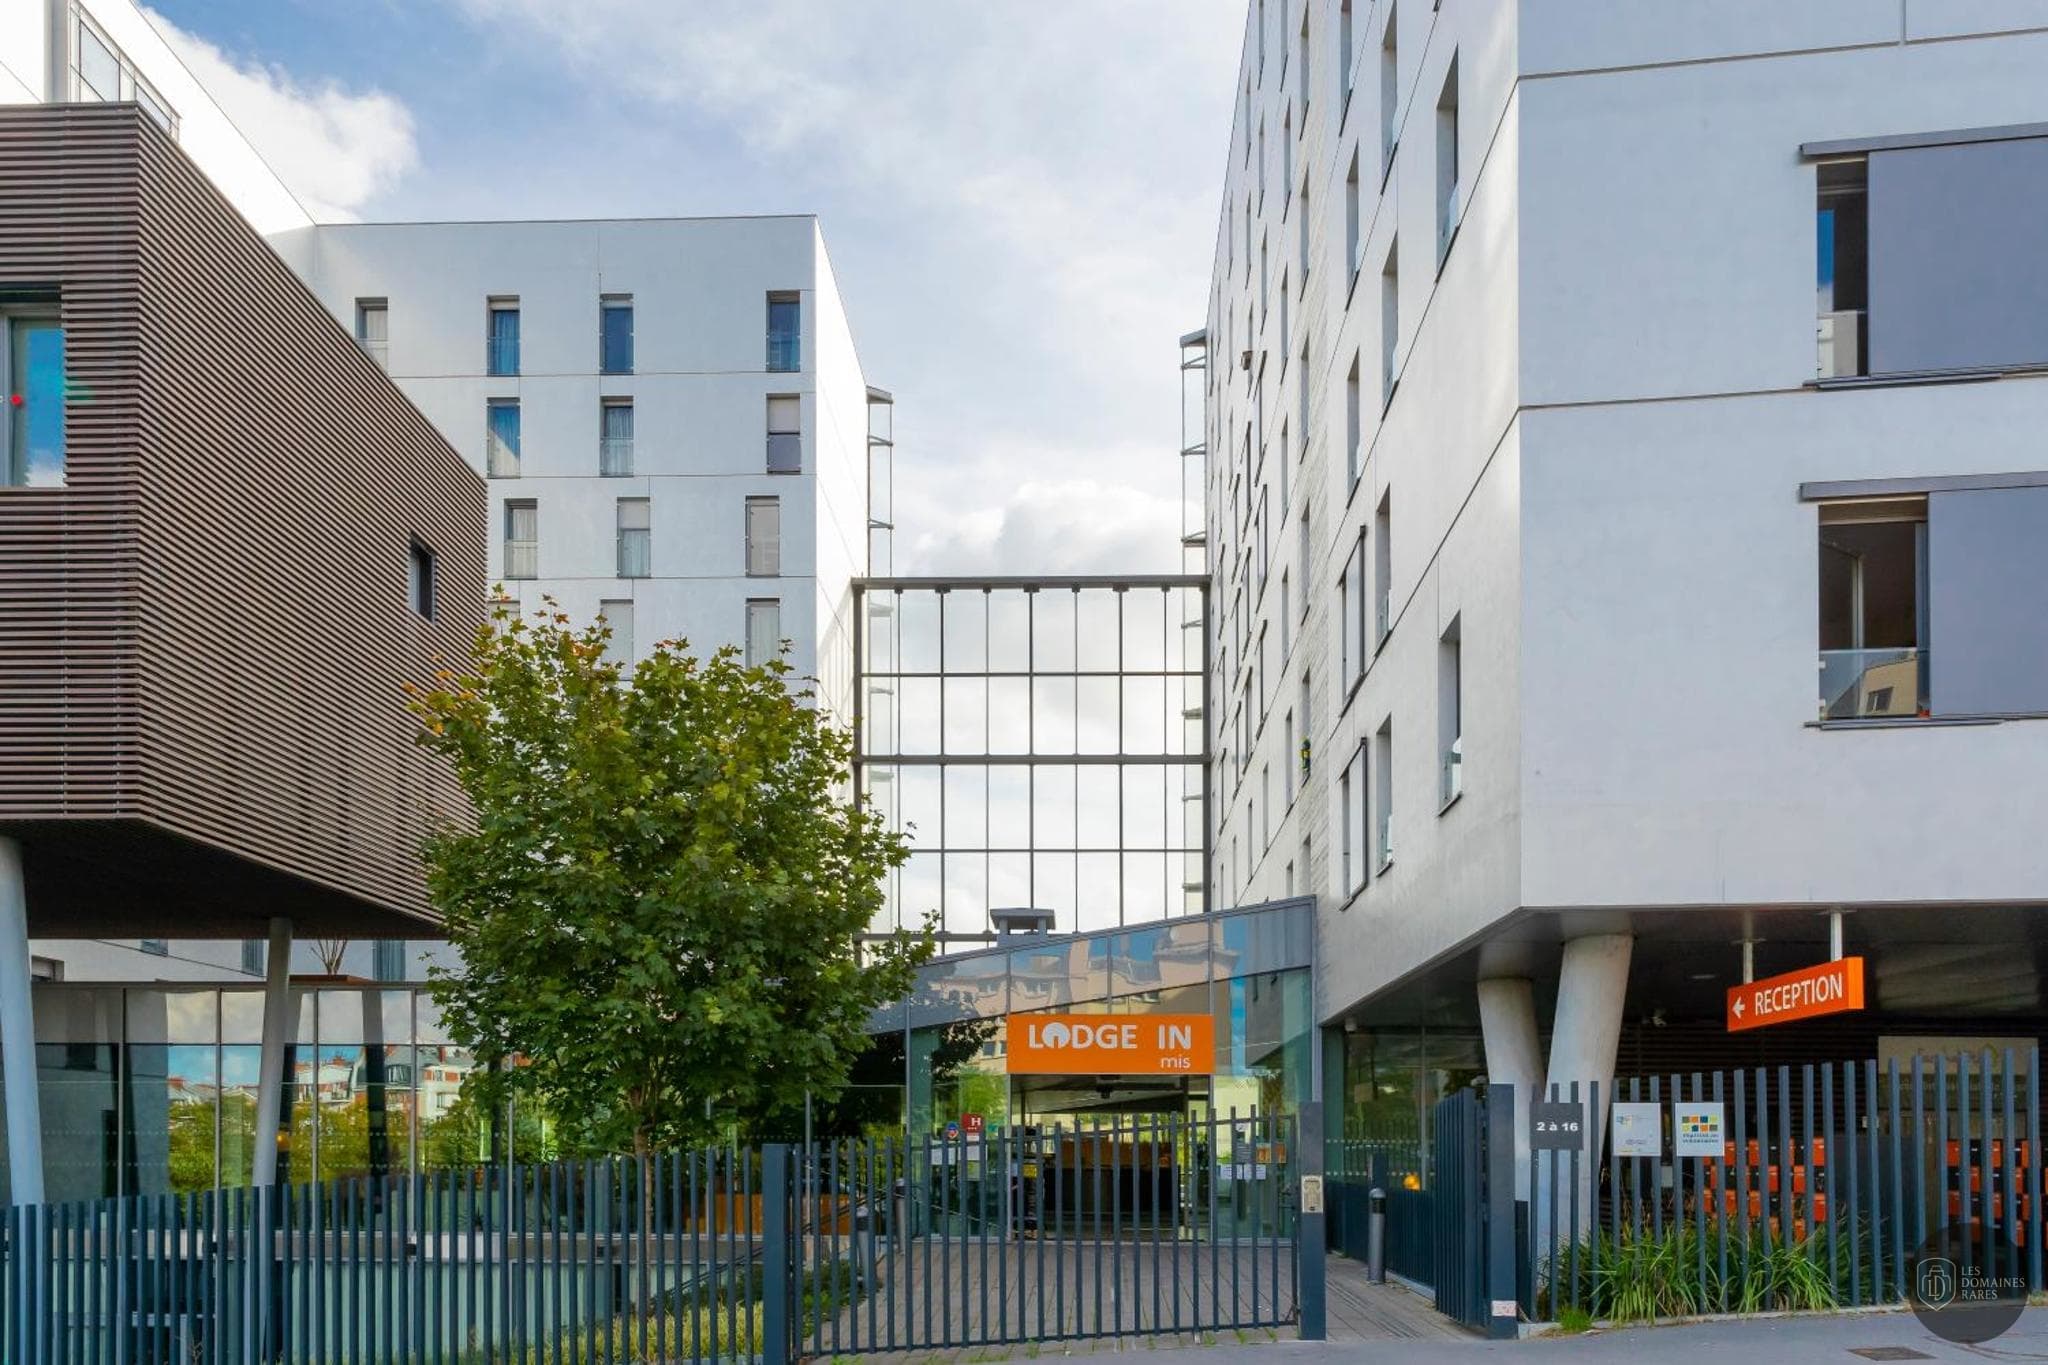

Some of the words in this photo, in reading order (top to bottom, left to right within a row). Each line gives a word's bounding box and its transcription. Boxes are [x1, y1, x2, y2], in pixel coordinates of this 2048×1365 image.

[1755, 972, 1843, 1016] RECEPTION
[1028, 1022, 1138, 1050] LODGE
[1158, 1024, 1192, 1050] IN
[1160, 1056, 1191, 1069] mis
[1536, 1121, 1546, 1131] 2
[1561, 1122, 1578, 1131] 16
